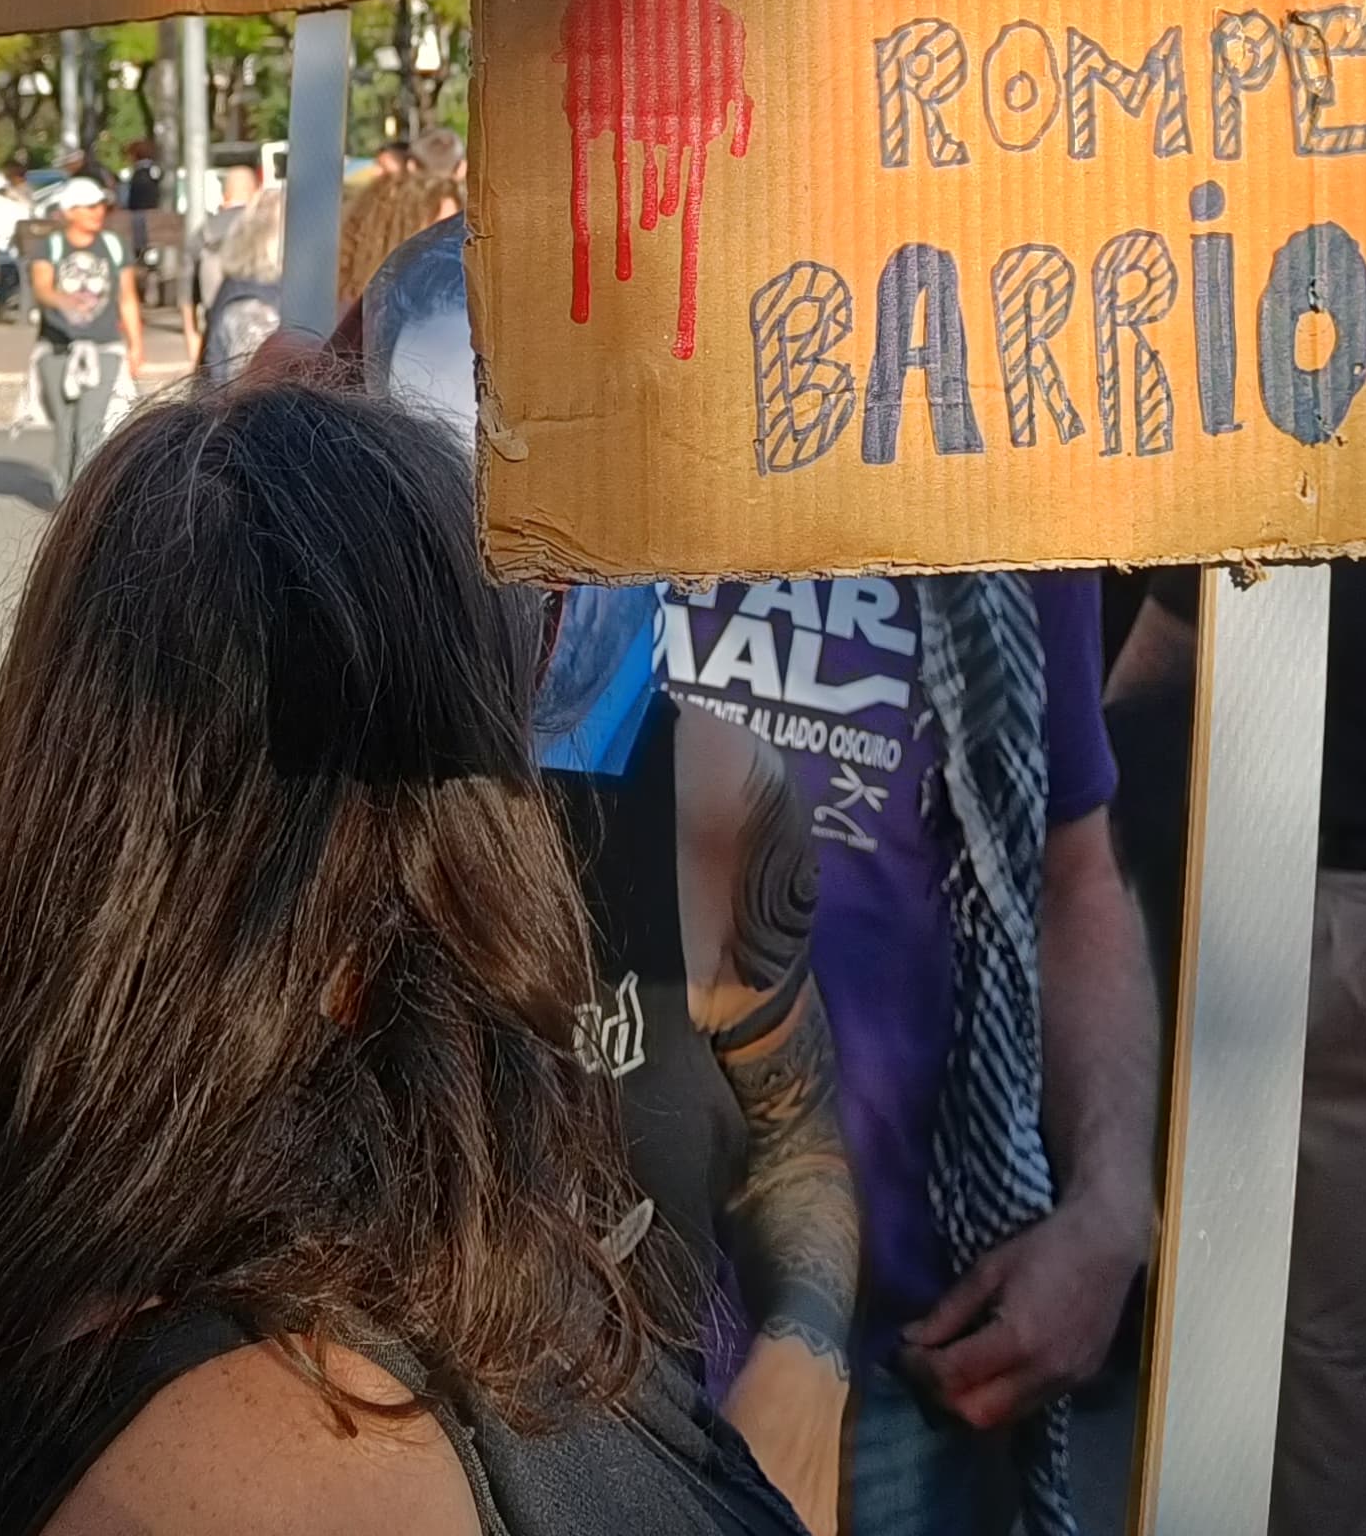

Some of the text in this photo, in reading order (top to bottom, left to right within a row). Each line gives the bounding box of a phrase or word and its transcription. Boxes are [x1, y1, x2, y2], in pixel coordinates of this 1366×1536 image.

[750, 707, 772, 743] AL
[774, 713, 828, 754] LADO
[829, 724, 902, 774] OSCURO
